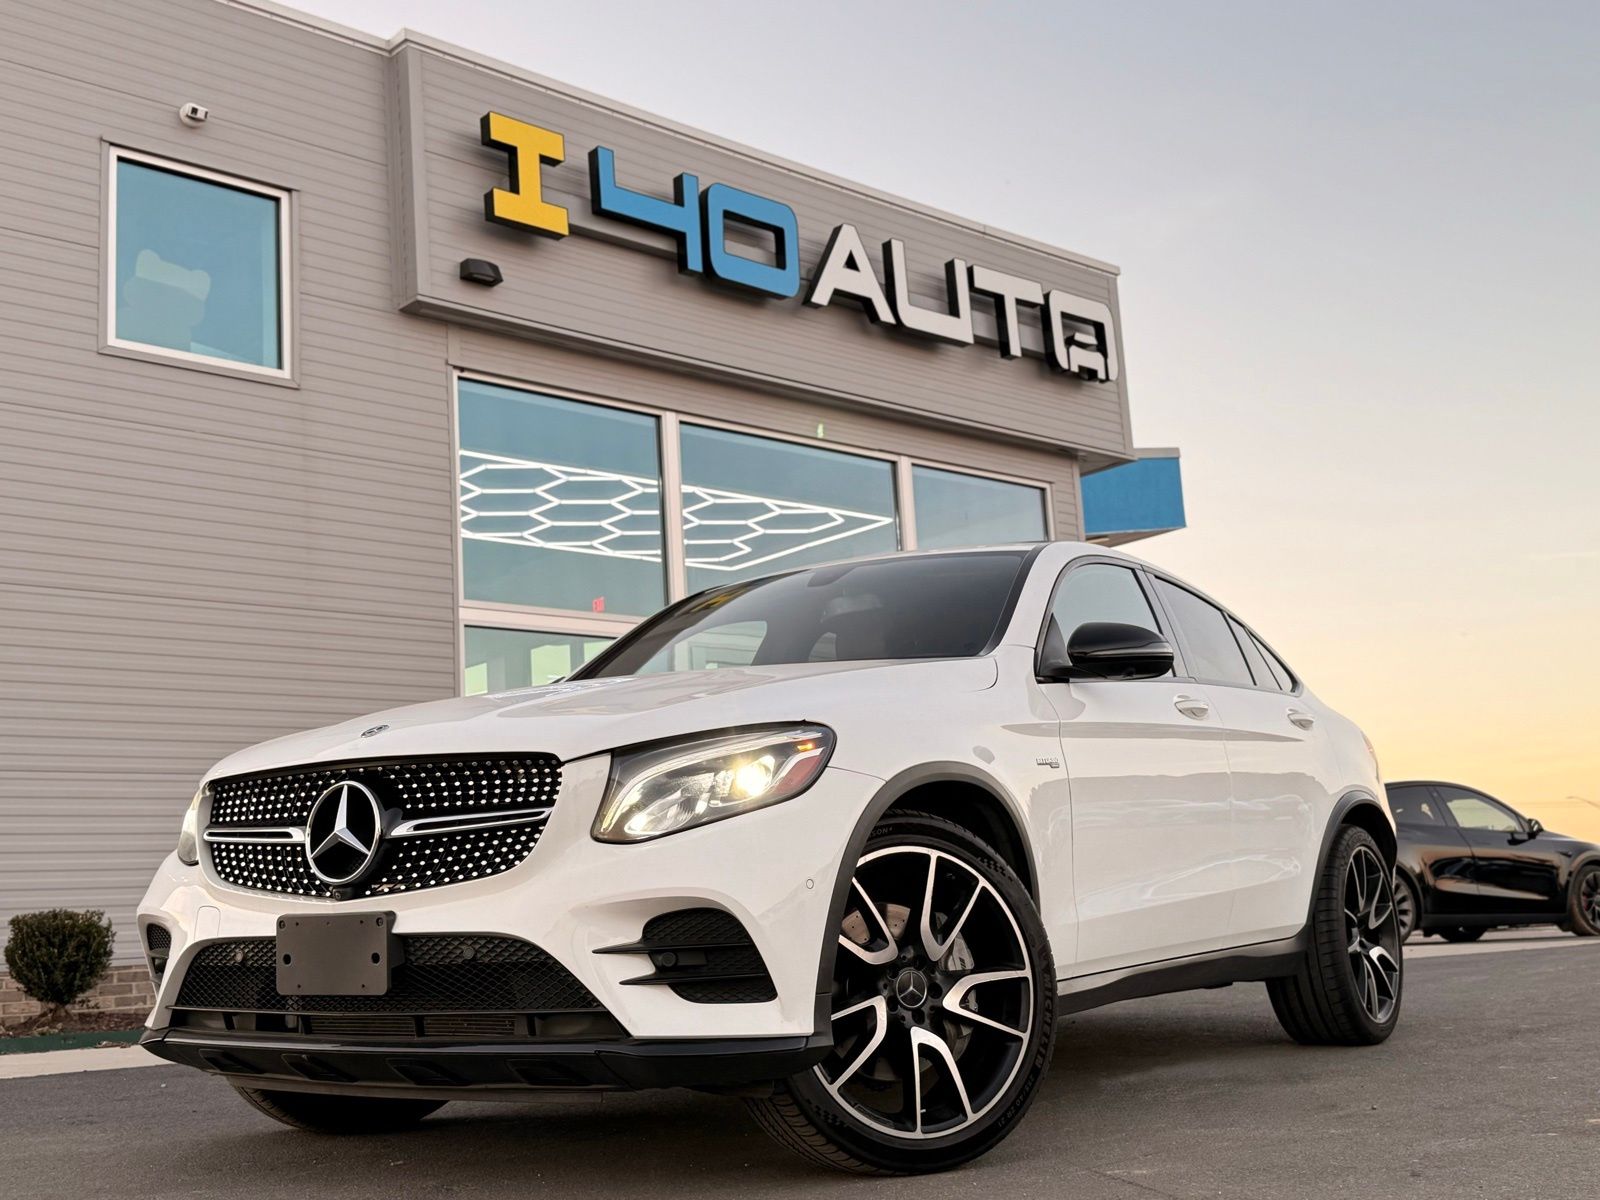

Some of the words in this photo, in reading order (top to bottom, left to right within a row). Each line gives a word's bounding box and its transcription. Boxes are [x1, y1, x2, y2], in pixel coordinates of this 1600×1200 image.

[481, 111, 569, 240] I
[588, 146, 800, 299] 40
[1035, 973, 1053, 1068] MICHELIN
